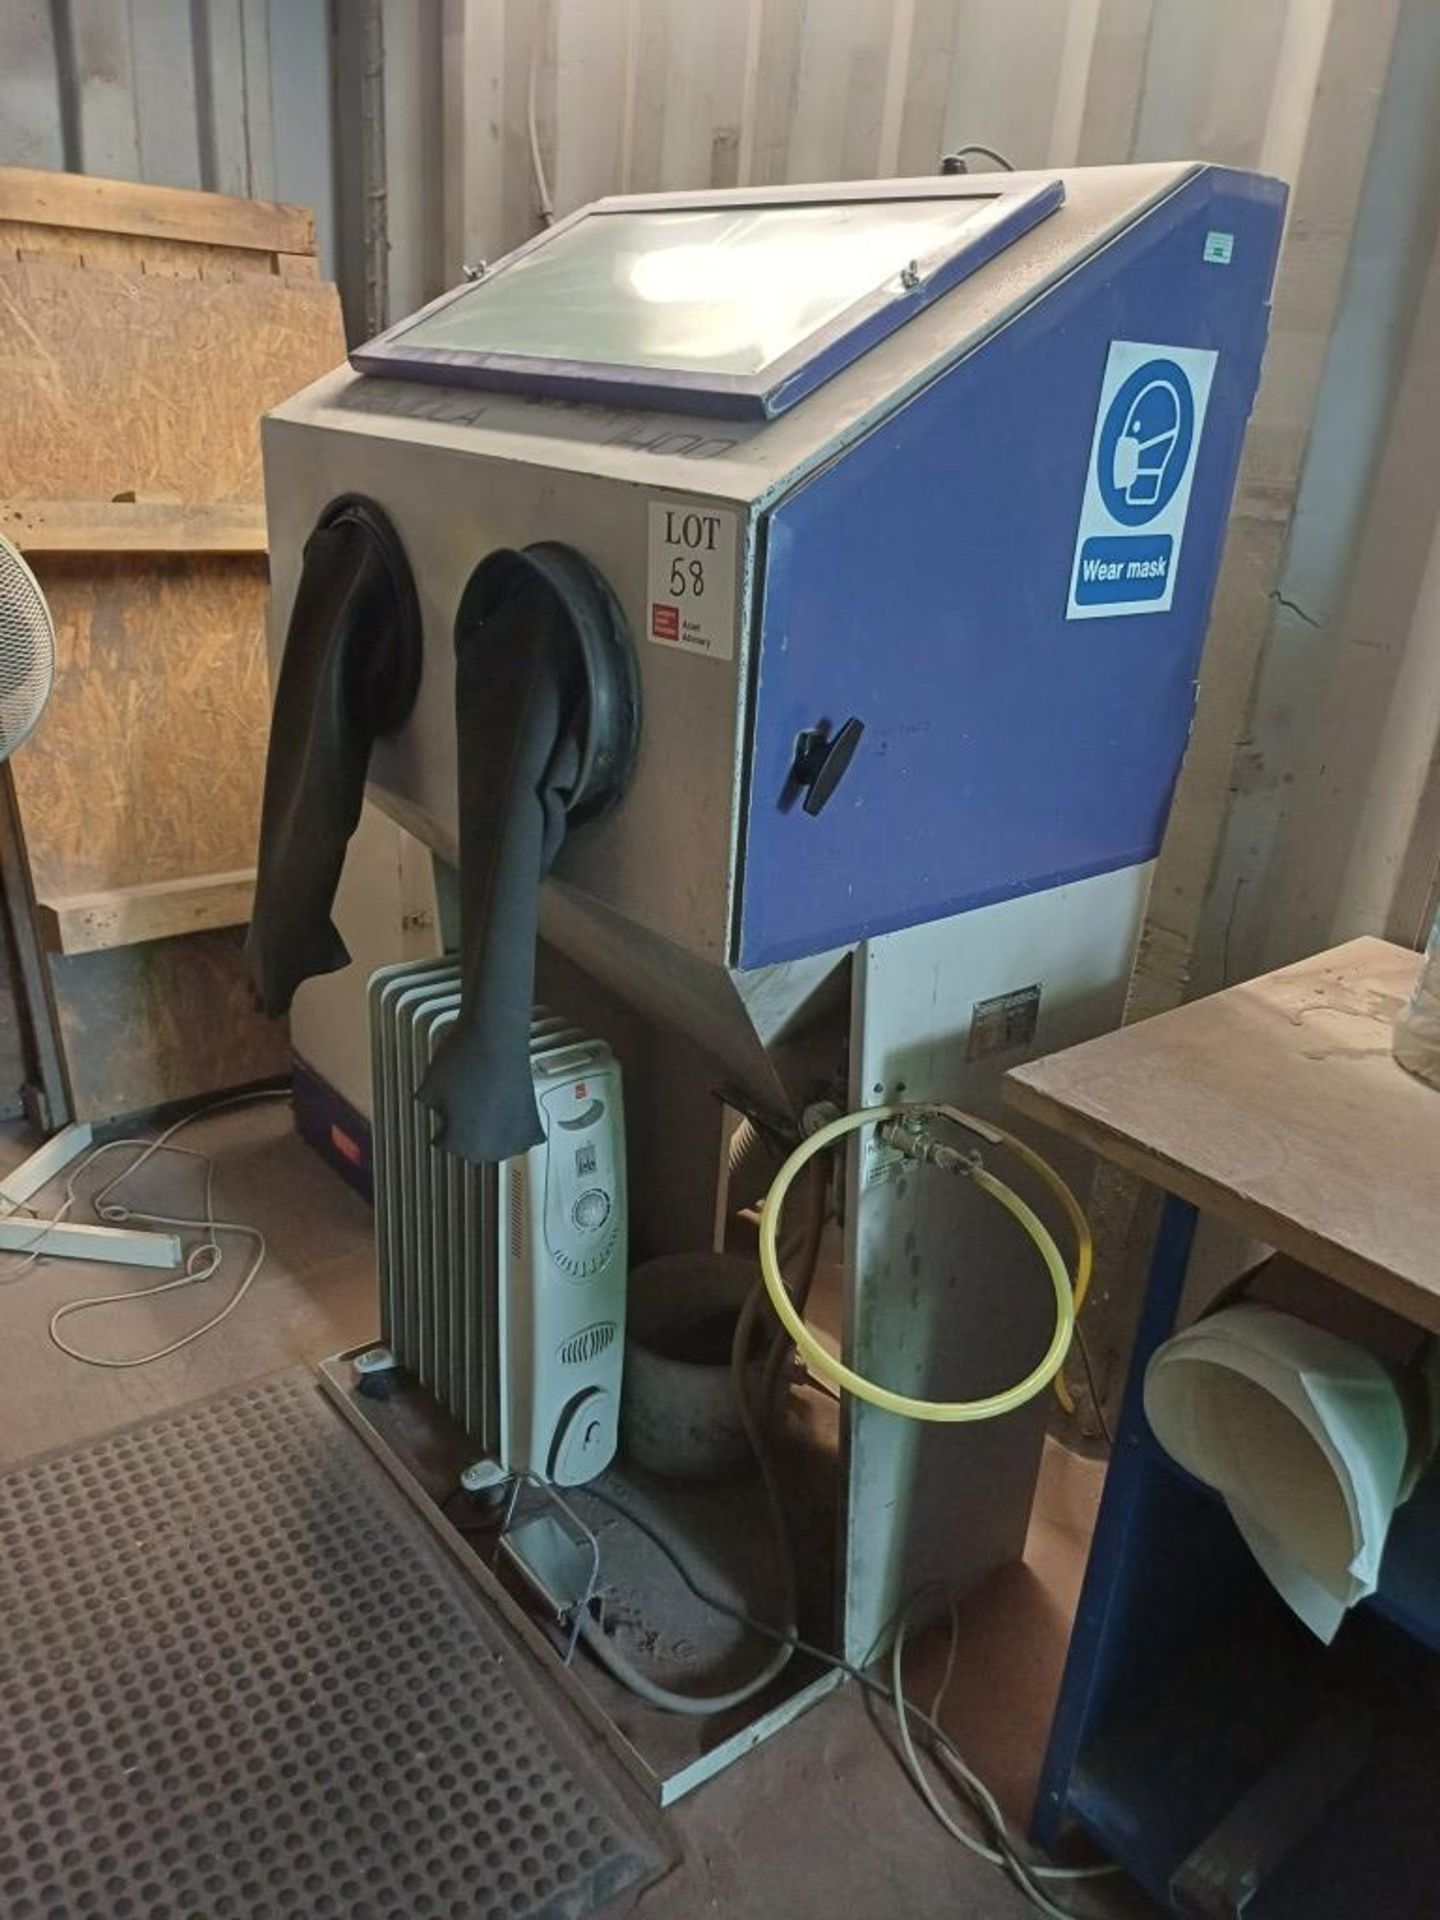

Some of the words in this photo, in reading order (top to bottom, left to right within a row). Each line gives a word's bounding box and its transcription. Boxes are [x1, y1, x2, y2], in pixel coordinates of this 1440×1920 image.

[665, 511, 720, 550] LOT
[669, 556, 704, 597] 58
[1083, 558, 1124, 582] Wear
[1126, 556, 1167, 579] mask
